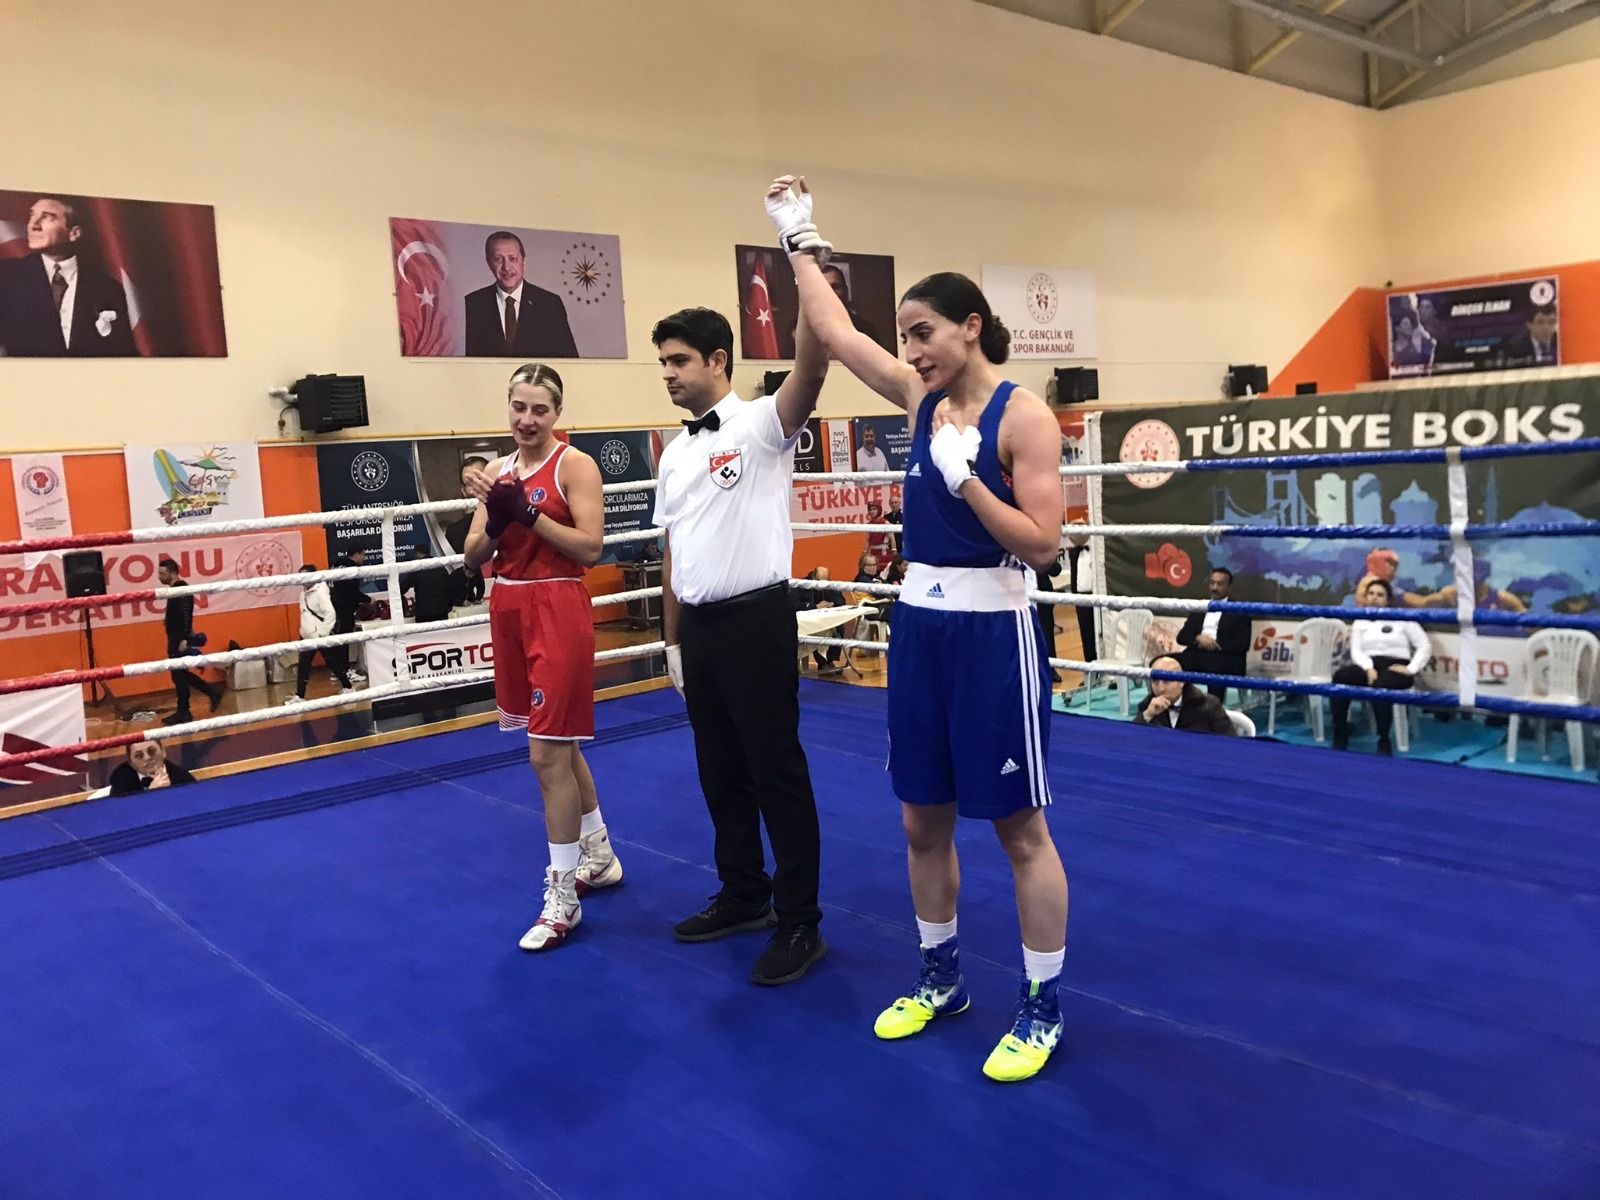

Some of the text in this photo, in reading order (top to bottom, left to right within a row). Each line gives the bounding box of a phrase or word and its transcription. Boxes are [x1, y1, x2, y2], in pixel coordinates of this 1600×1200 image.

[1013, 328, 1074, 342] T.C. GENÇLİK VE
[1013, 341, 1075, 353] SPOR BAKANLIĞI
[1186, 402, 1585, 457] TÜRKİYE BOKS
[797, 485, 883, 511] TÜRKİYE
[336, 523, 414, 539] BAŞARILAR DORUM
[0, 548, 223, 597] RAYONU
[1261, 641, 1294, 662] aib
